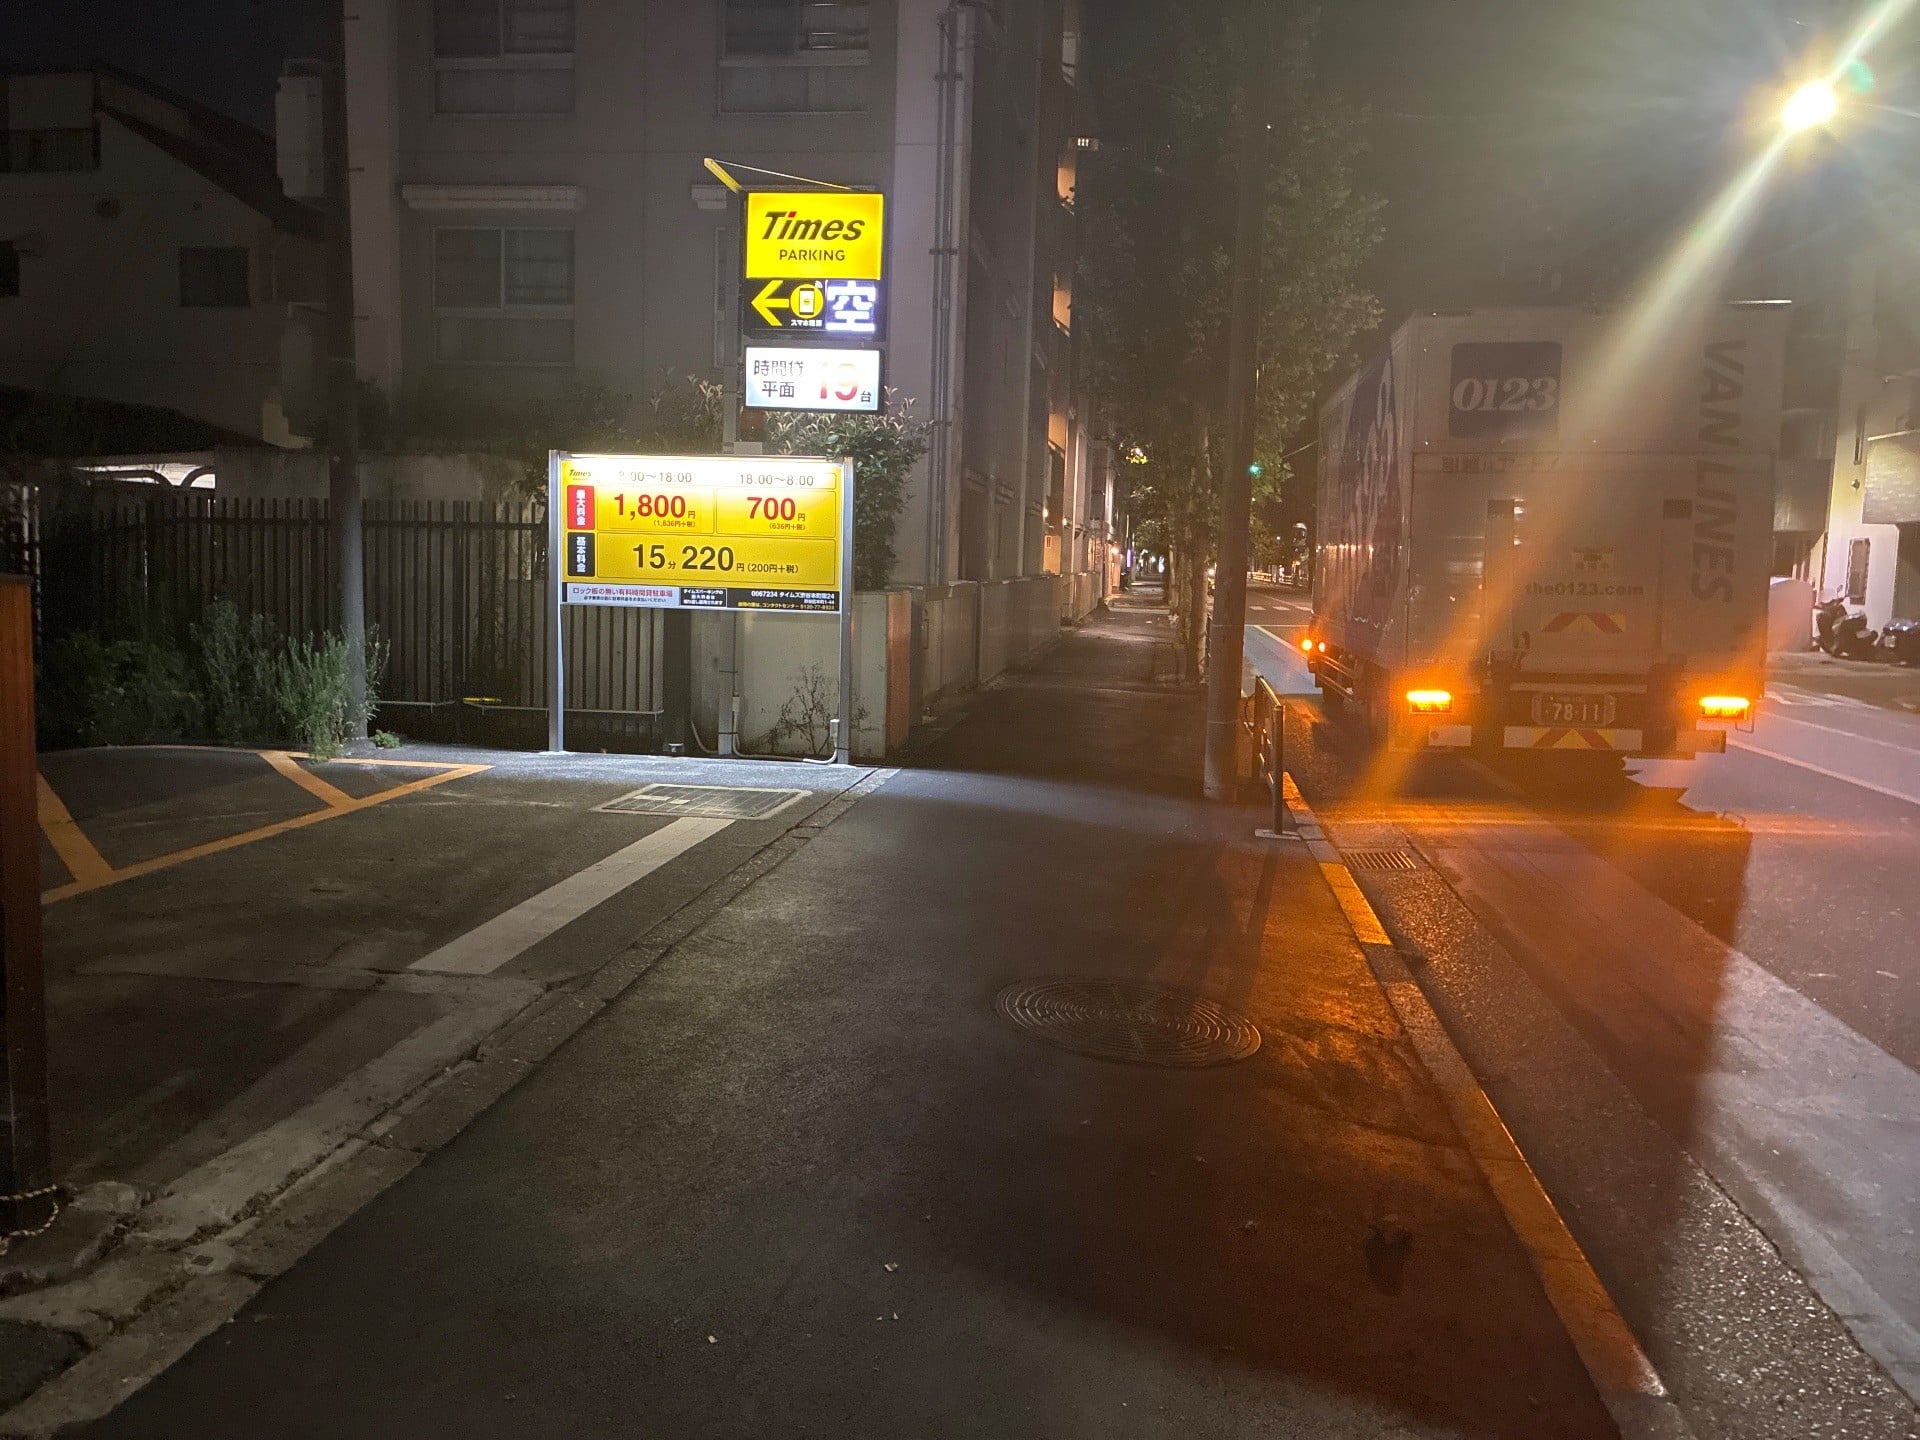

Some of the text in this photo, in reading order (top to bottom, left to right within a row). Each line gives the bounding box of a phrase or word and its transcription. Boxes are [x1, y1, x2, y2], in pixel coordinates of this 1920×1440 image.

[762, 211, 865, 241] Times
[779, 249, 846, 261] PARKING
[826, 280, 876, 331] 空
[762, 381, 796, 398] 平面
[1453, 378, 1558, 411] 0123
[1693, 340, 1746, 602] VAN LINES
